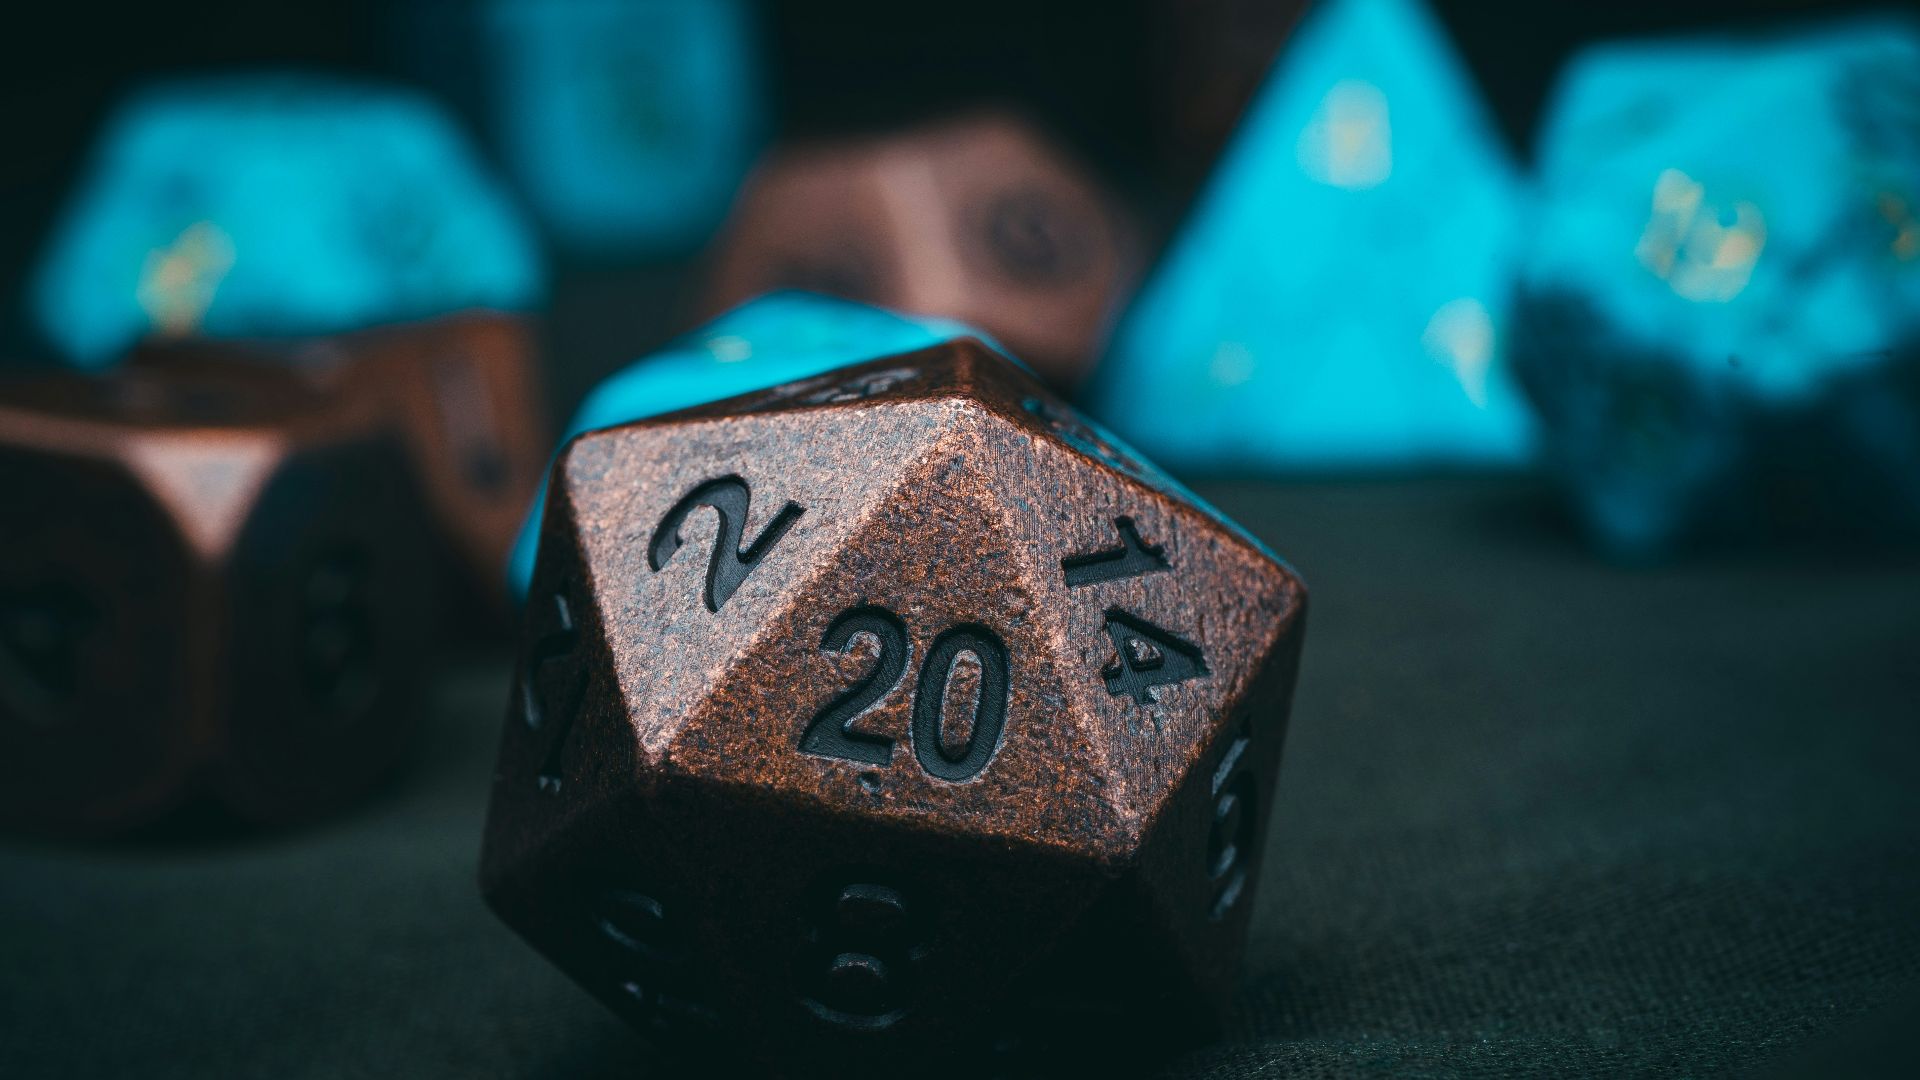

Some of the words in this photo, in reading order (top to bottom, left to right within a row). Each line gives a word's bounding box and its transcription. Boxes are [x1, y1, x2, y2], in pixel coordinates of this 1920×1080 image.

[648, 473, 807, 616] 2
[1060, 514, 1212, 704] 14
[798, 604, 1011, 784] 20
